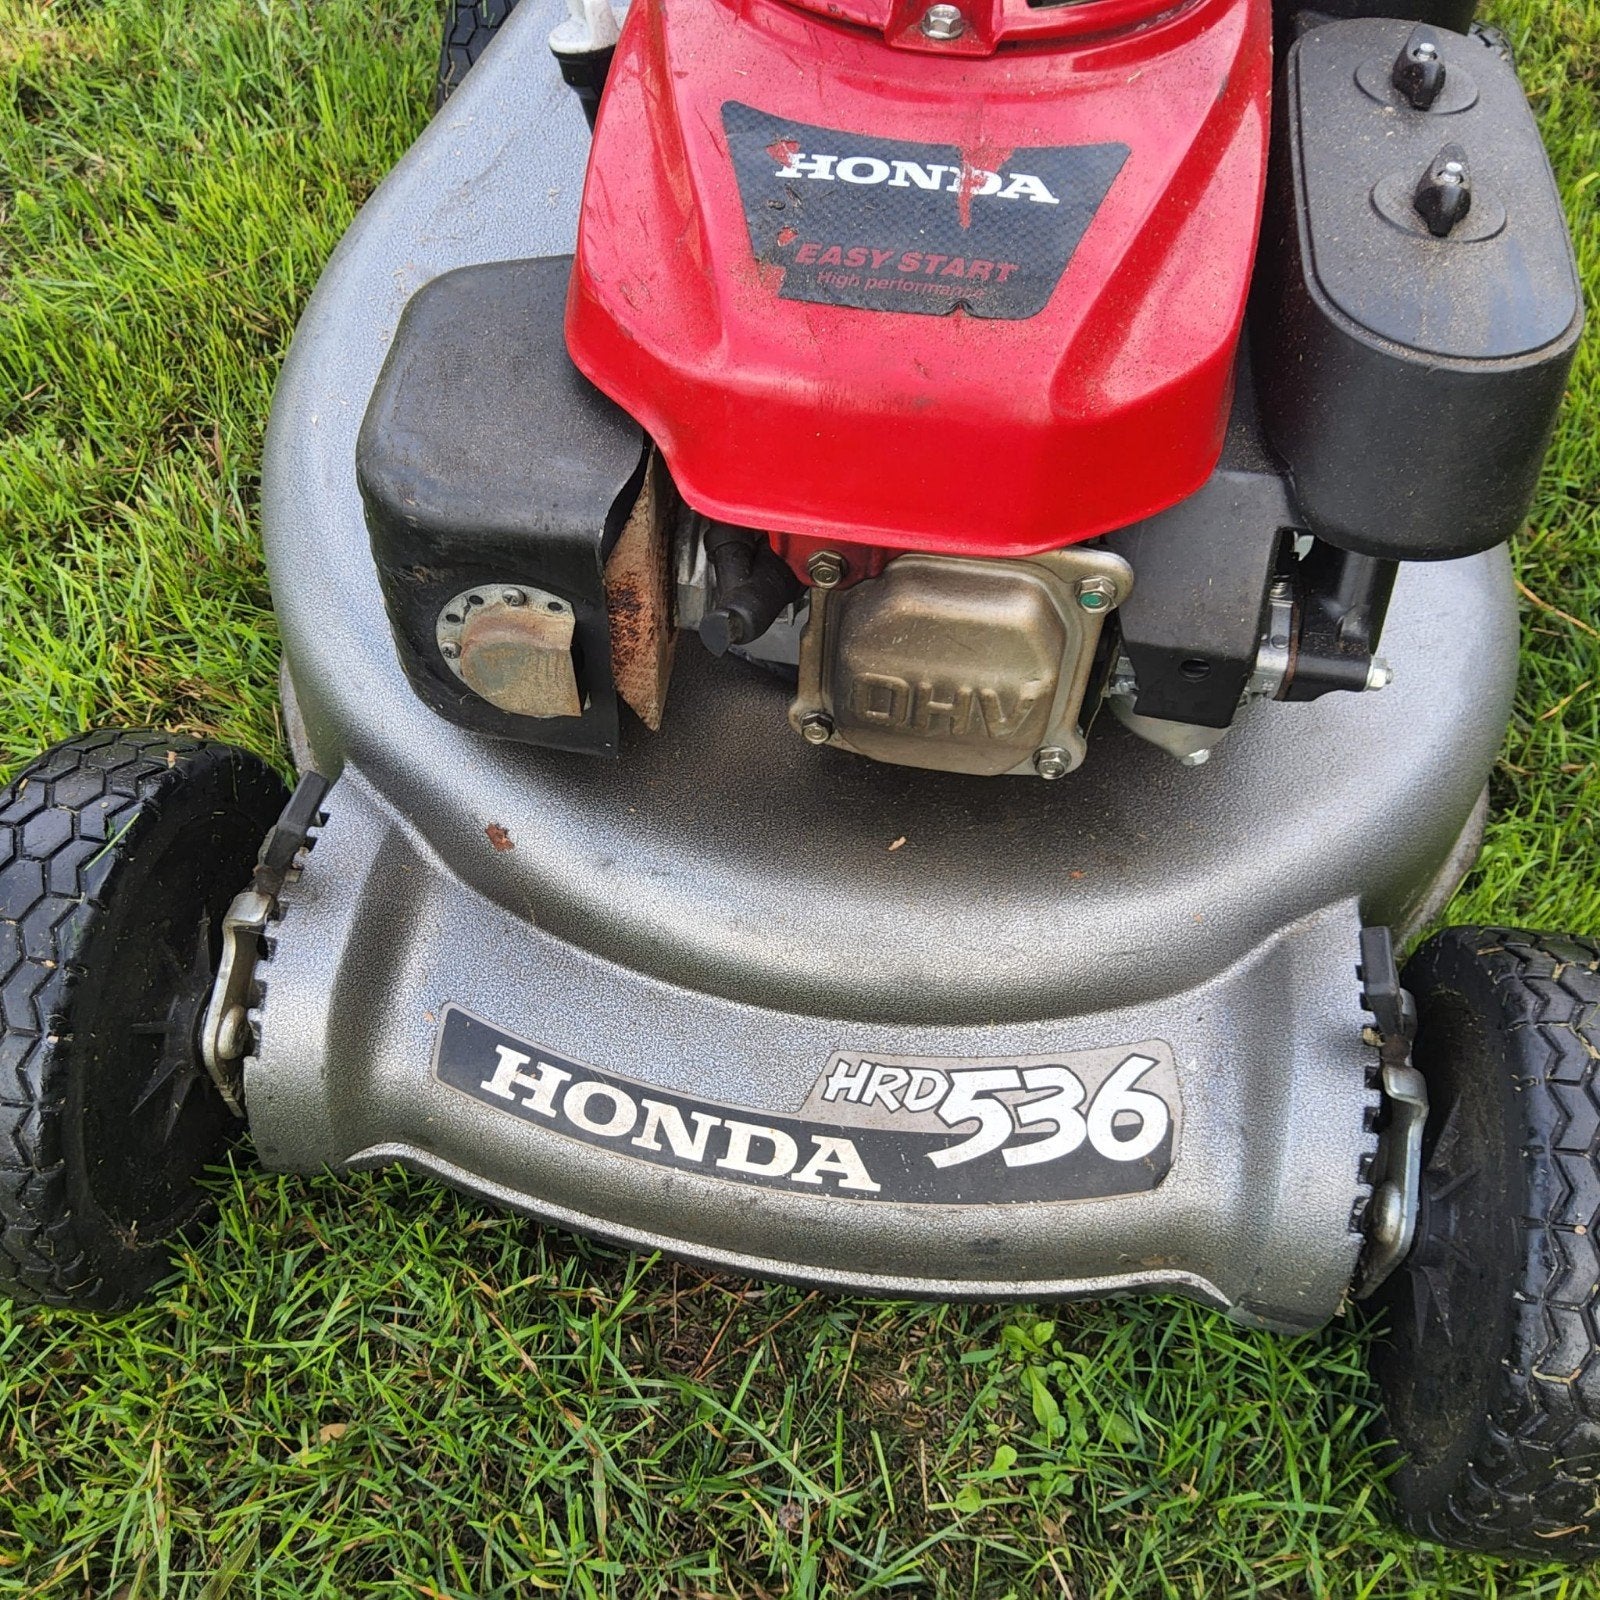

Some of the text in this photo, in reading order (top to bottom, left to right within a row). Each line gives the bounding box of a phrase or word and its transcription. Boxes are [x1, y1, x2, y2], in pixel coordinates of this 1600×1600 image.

[774, 153, 1060, 205] HONDA
[795, 243, 1021, 283] EASY START
[817, 271, 860, 289] High
[851, 673, 1046, 738] OHV
[480, 1043, 882, 1194] HONDA
[824, 1053, 1170, 1170] HRD 536
